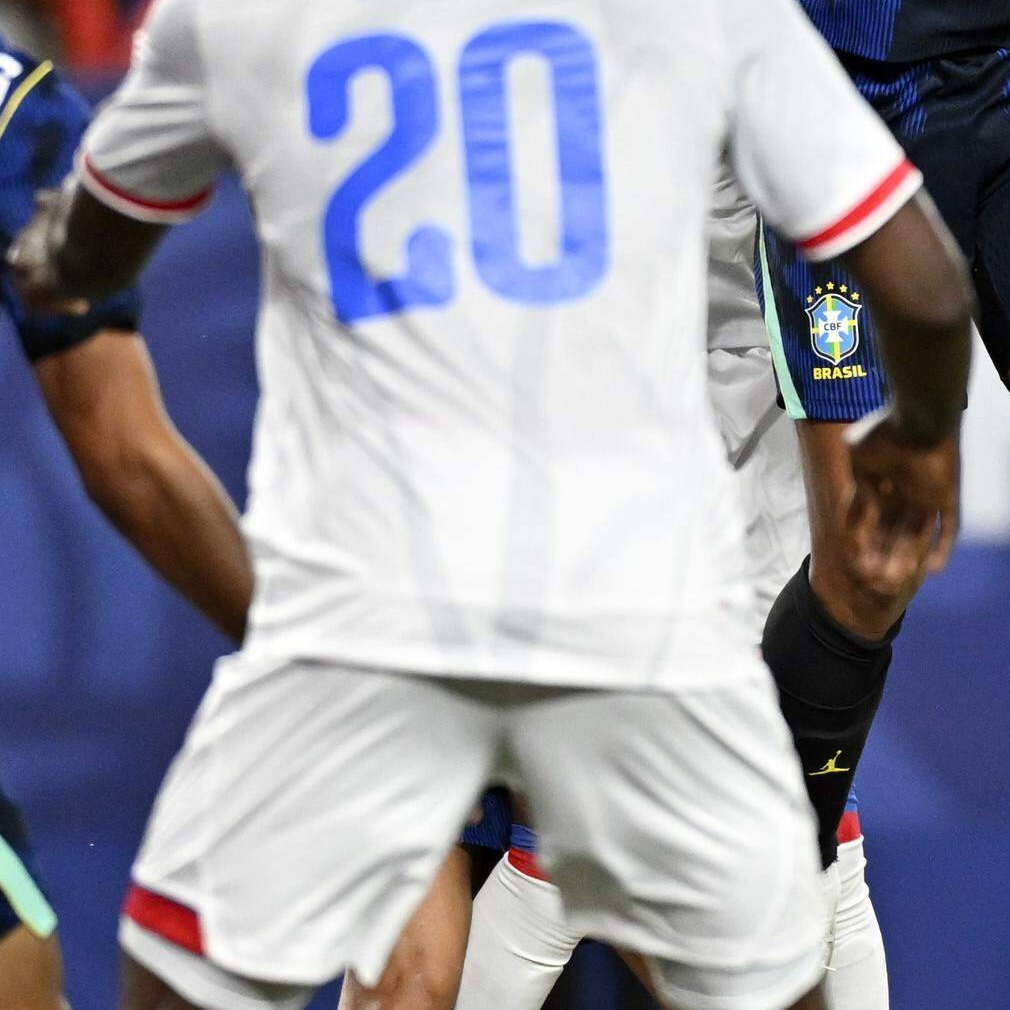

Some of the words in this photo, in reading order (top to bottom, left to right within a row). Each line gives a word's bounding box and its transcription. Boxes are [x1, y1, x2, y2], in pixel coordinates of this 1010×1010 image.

[307, 22, 612, 326] 20
[823, 322, 843, 332] CBF
[813, 364, 868, 381] BRASIL
